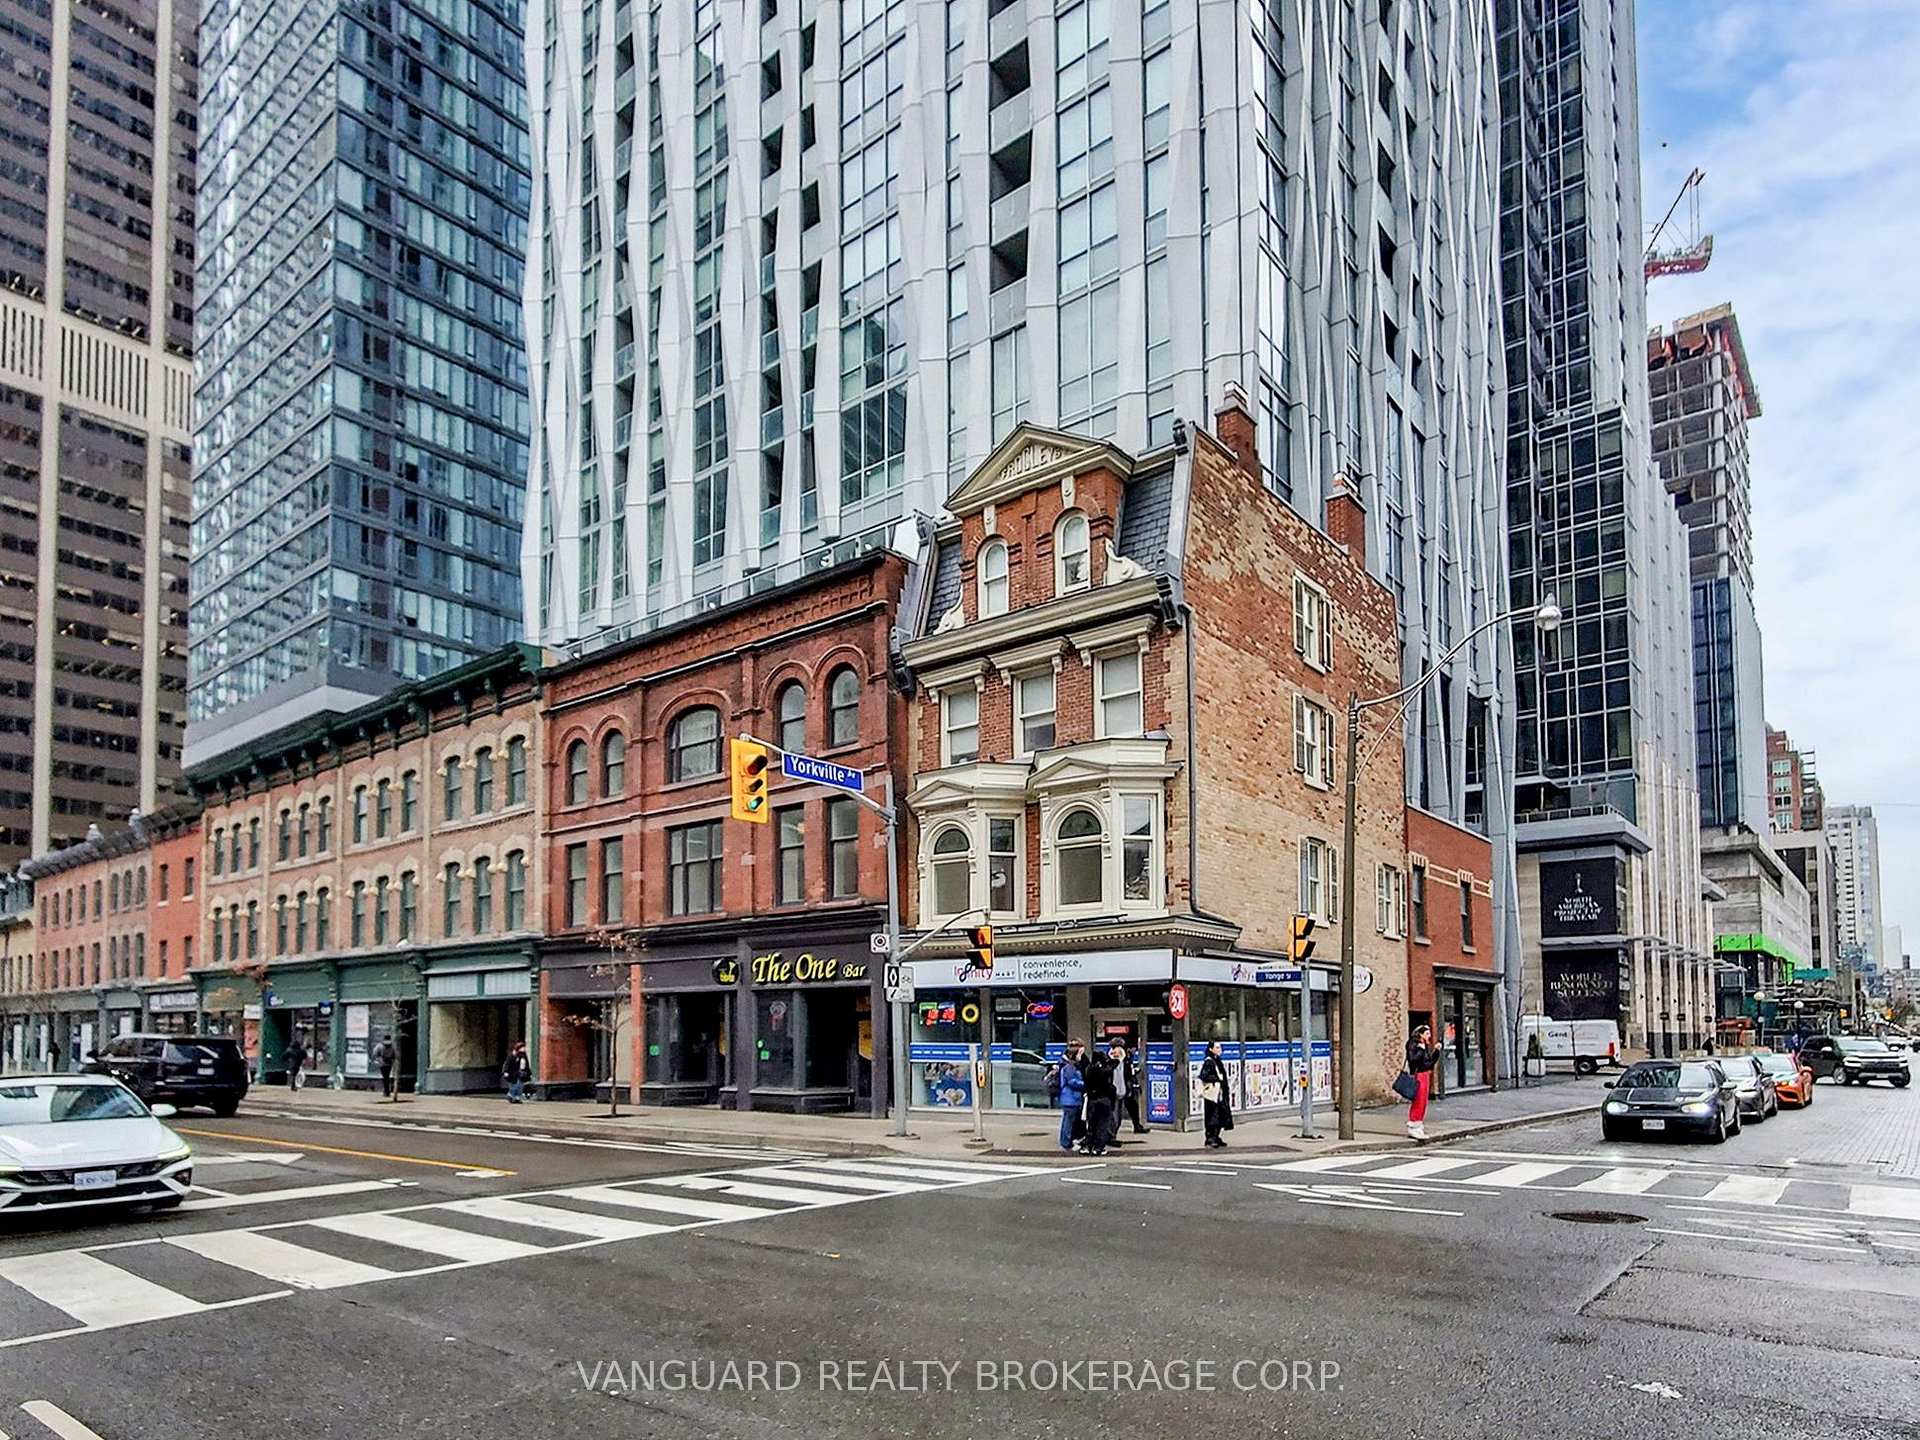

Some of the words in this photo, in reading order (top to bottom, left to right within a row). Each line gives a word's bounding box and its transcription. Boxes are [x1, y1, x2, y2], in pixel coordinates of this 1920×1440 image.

[791, 756, 844, 782] Yorkville
[752, 952, 791, 983] The
[795, 953, 837, 980] One
[843, 963, 866, 977] Bar
[1023, 969, 1069, 980] redefined.
